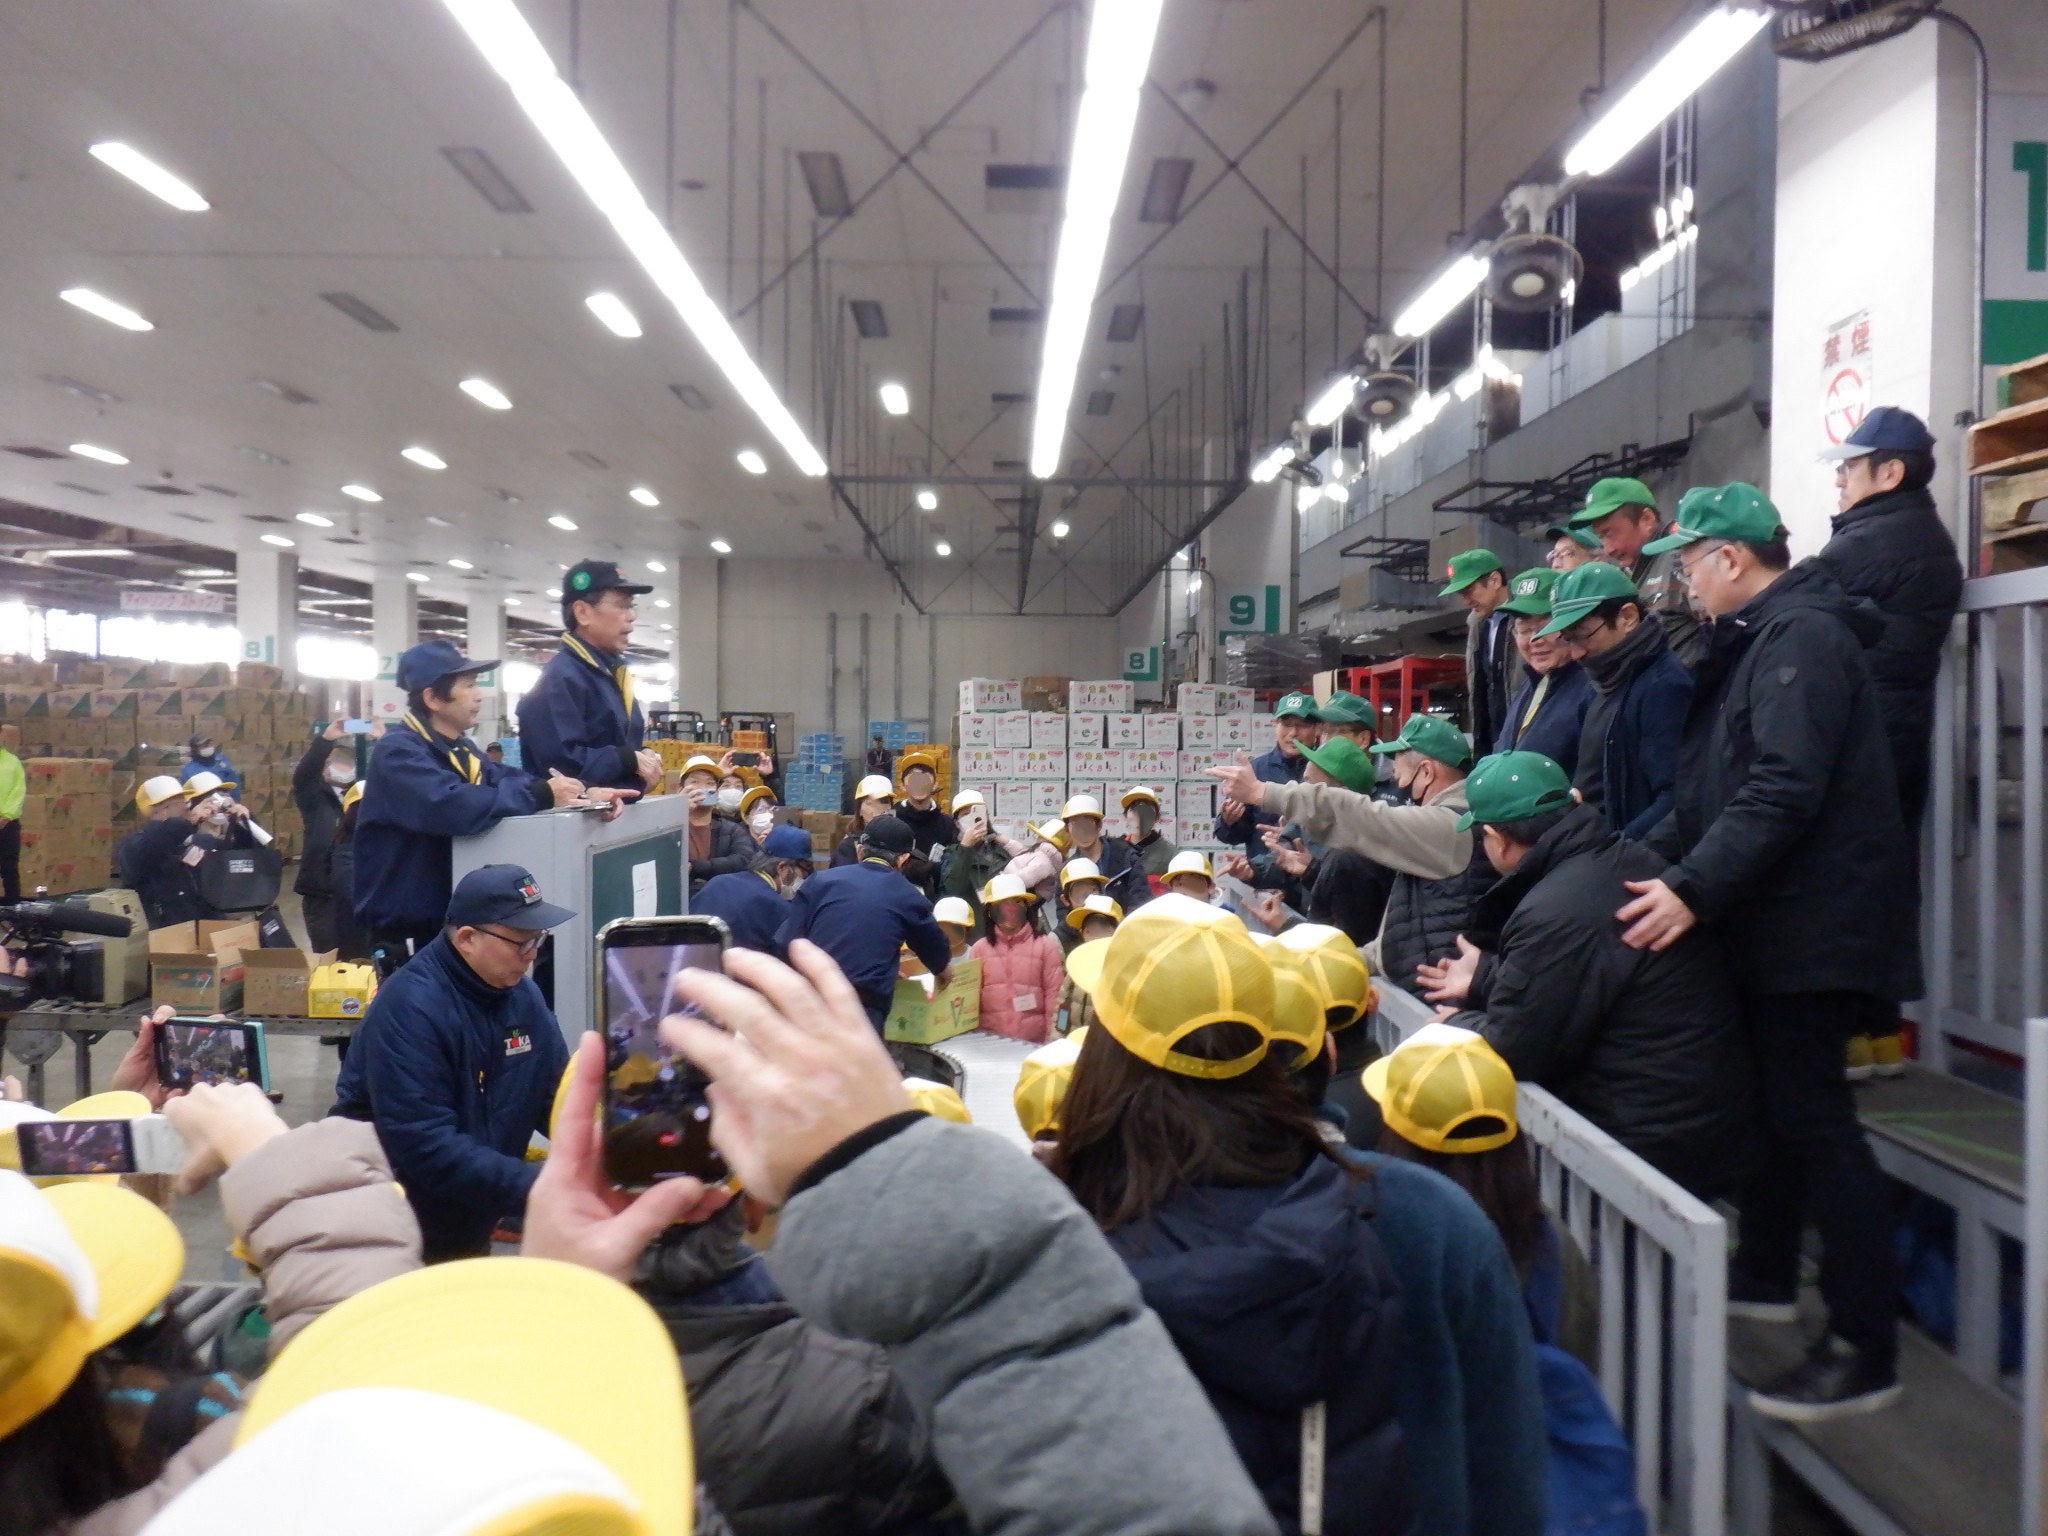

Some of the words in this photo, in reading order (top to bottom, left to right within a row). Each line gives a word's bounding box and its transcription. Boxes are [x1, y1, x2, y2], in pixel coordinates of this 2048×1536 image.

[1824, 320, 1869, 368] 禁煙
[1229, 595, 1256, 625] 9
[246, 641, 260, 658] 8
[1129, 653, 1145, 669] 8
